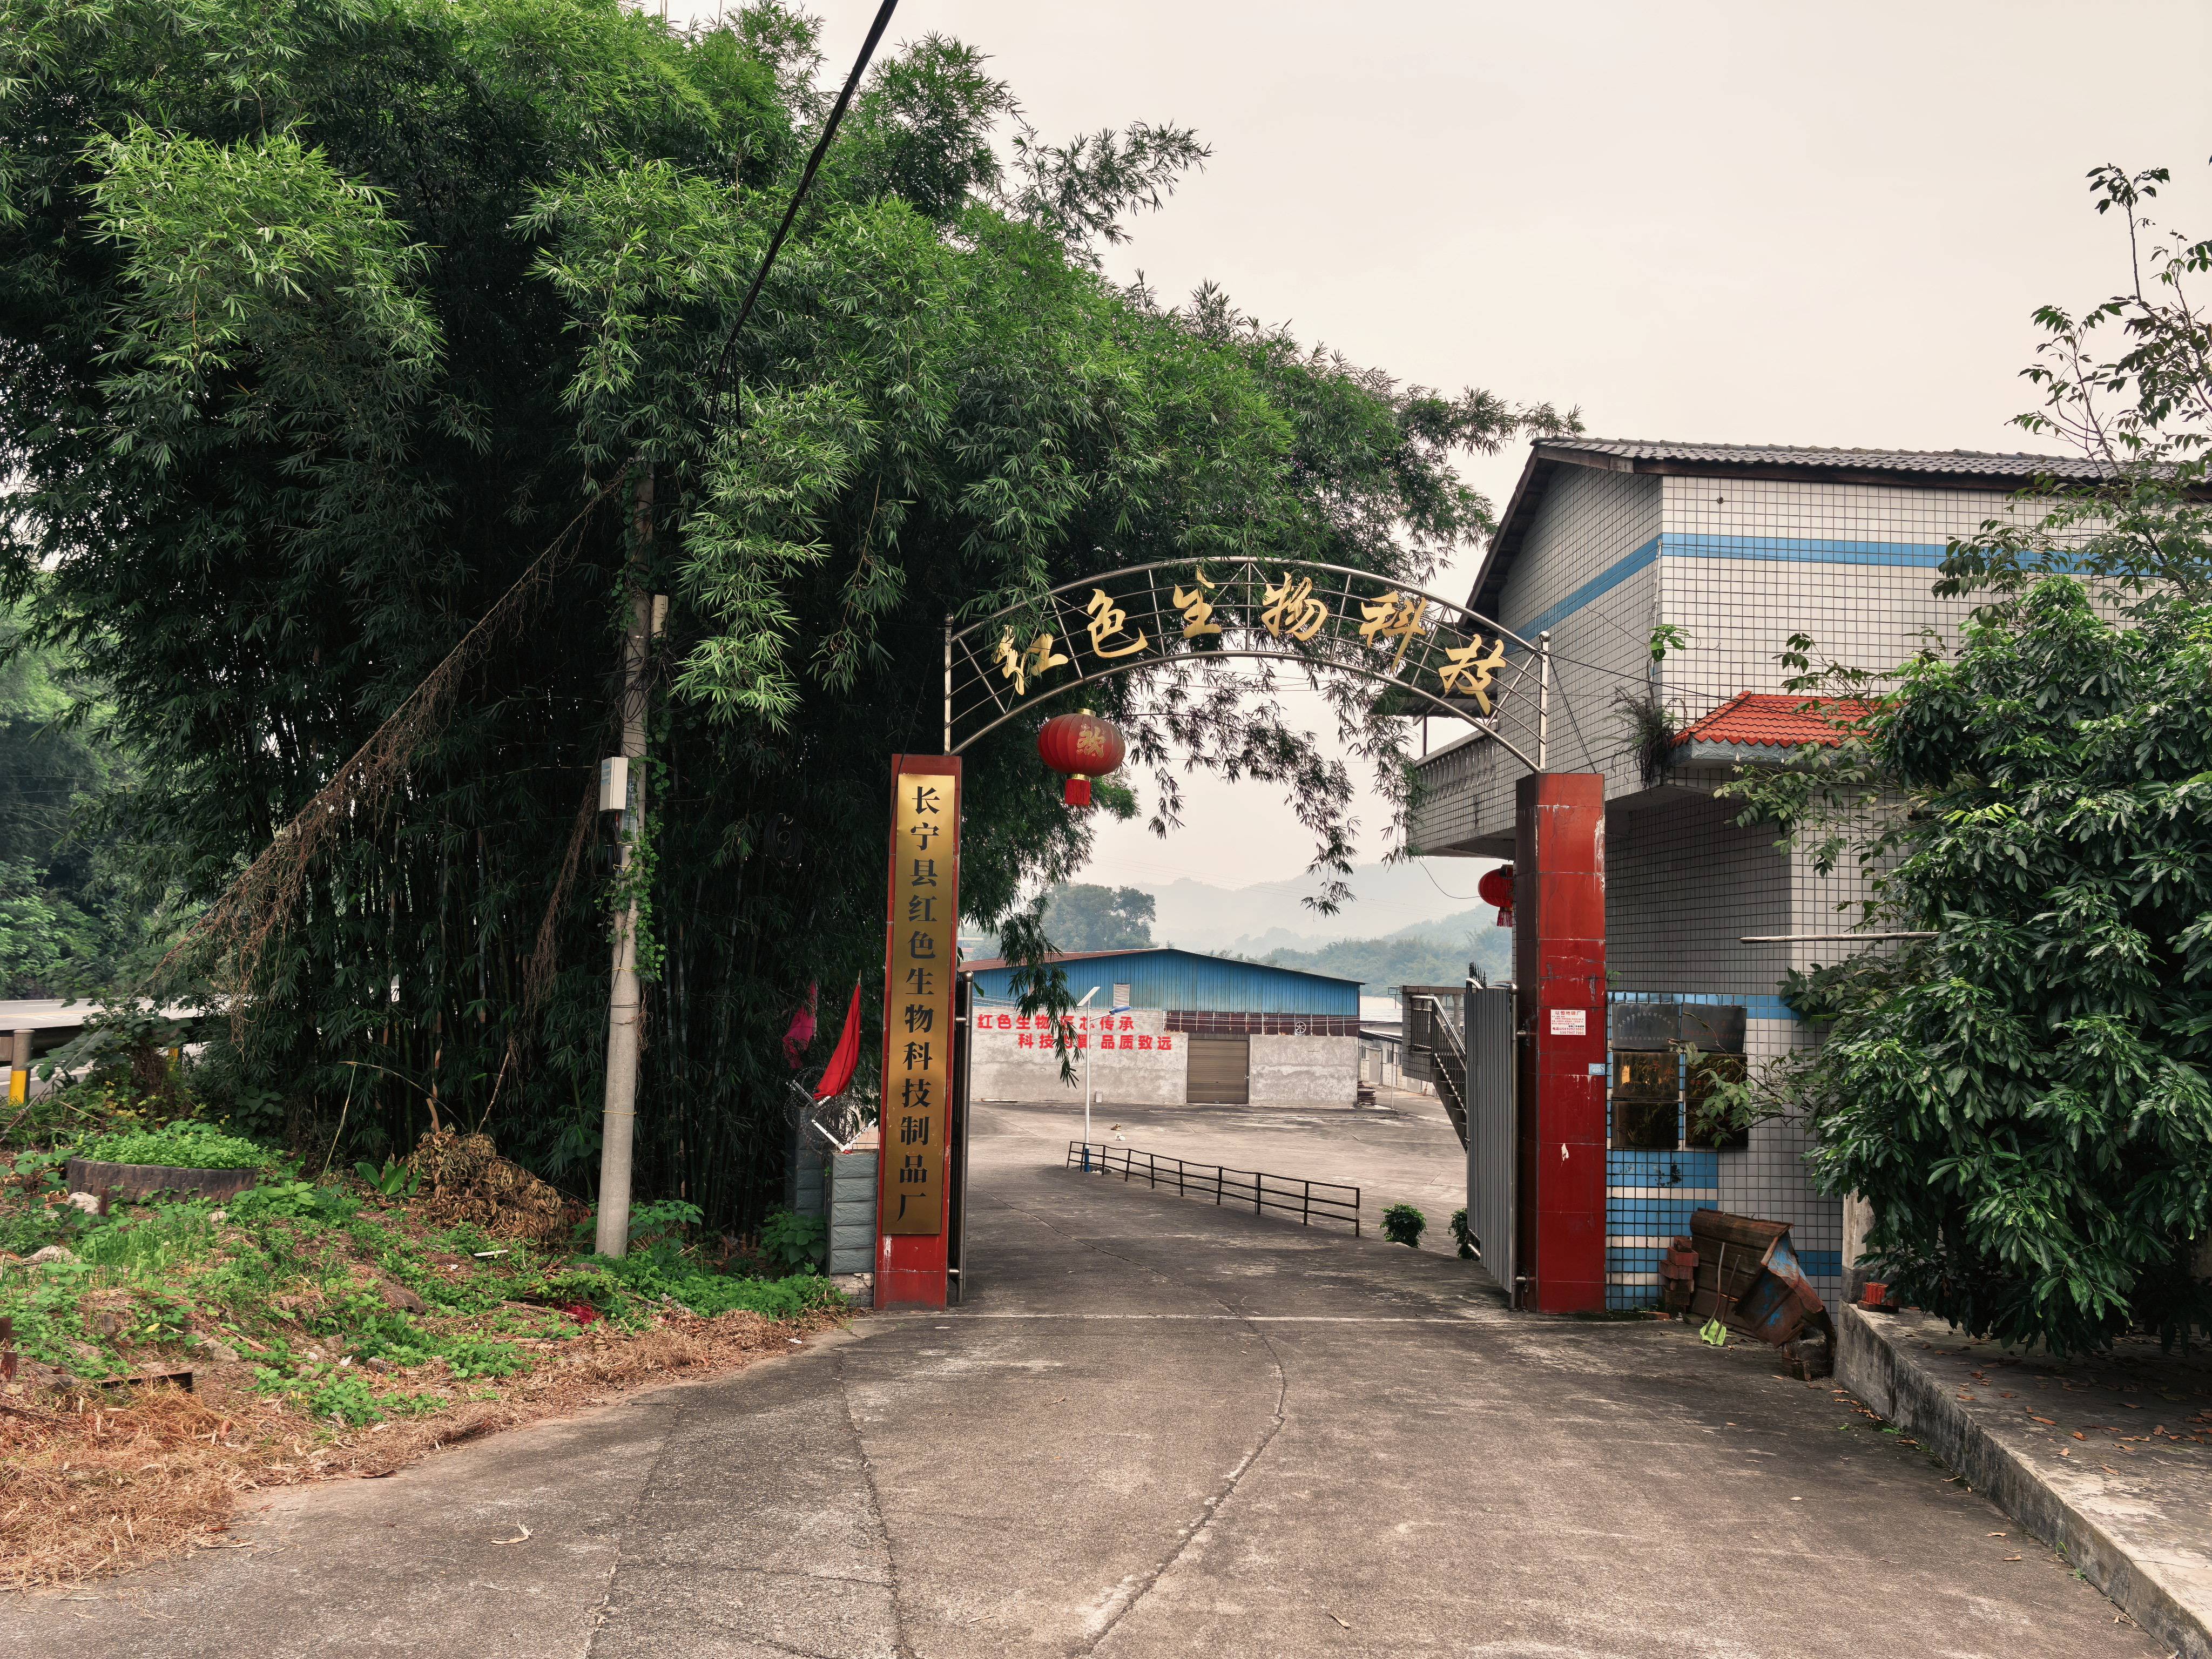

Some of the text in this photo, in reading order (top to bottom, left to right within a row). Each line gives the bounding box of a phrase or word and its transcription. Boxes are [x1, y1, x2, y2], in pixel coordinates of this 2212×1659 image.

[895, 785, 941, 1224] 长宁县红色生物科技制品厂
